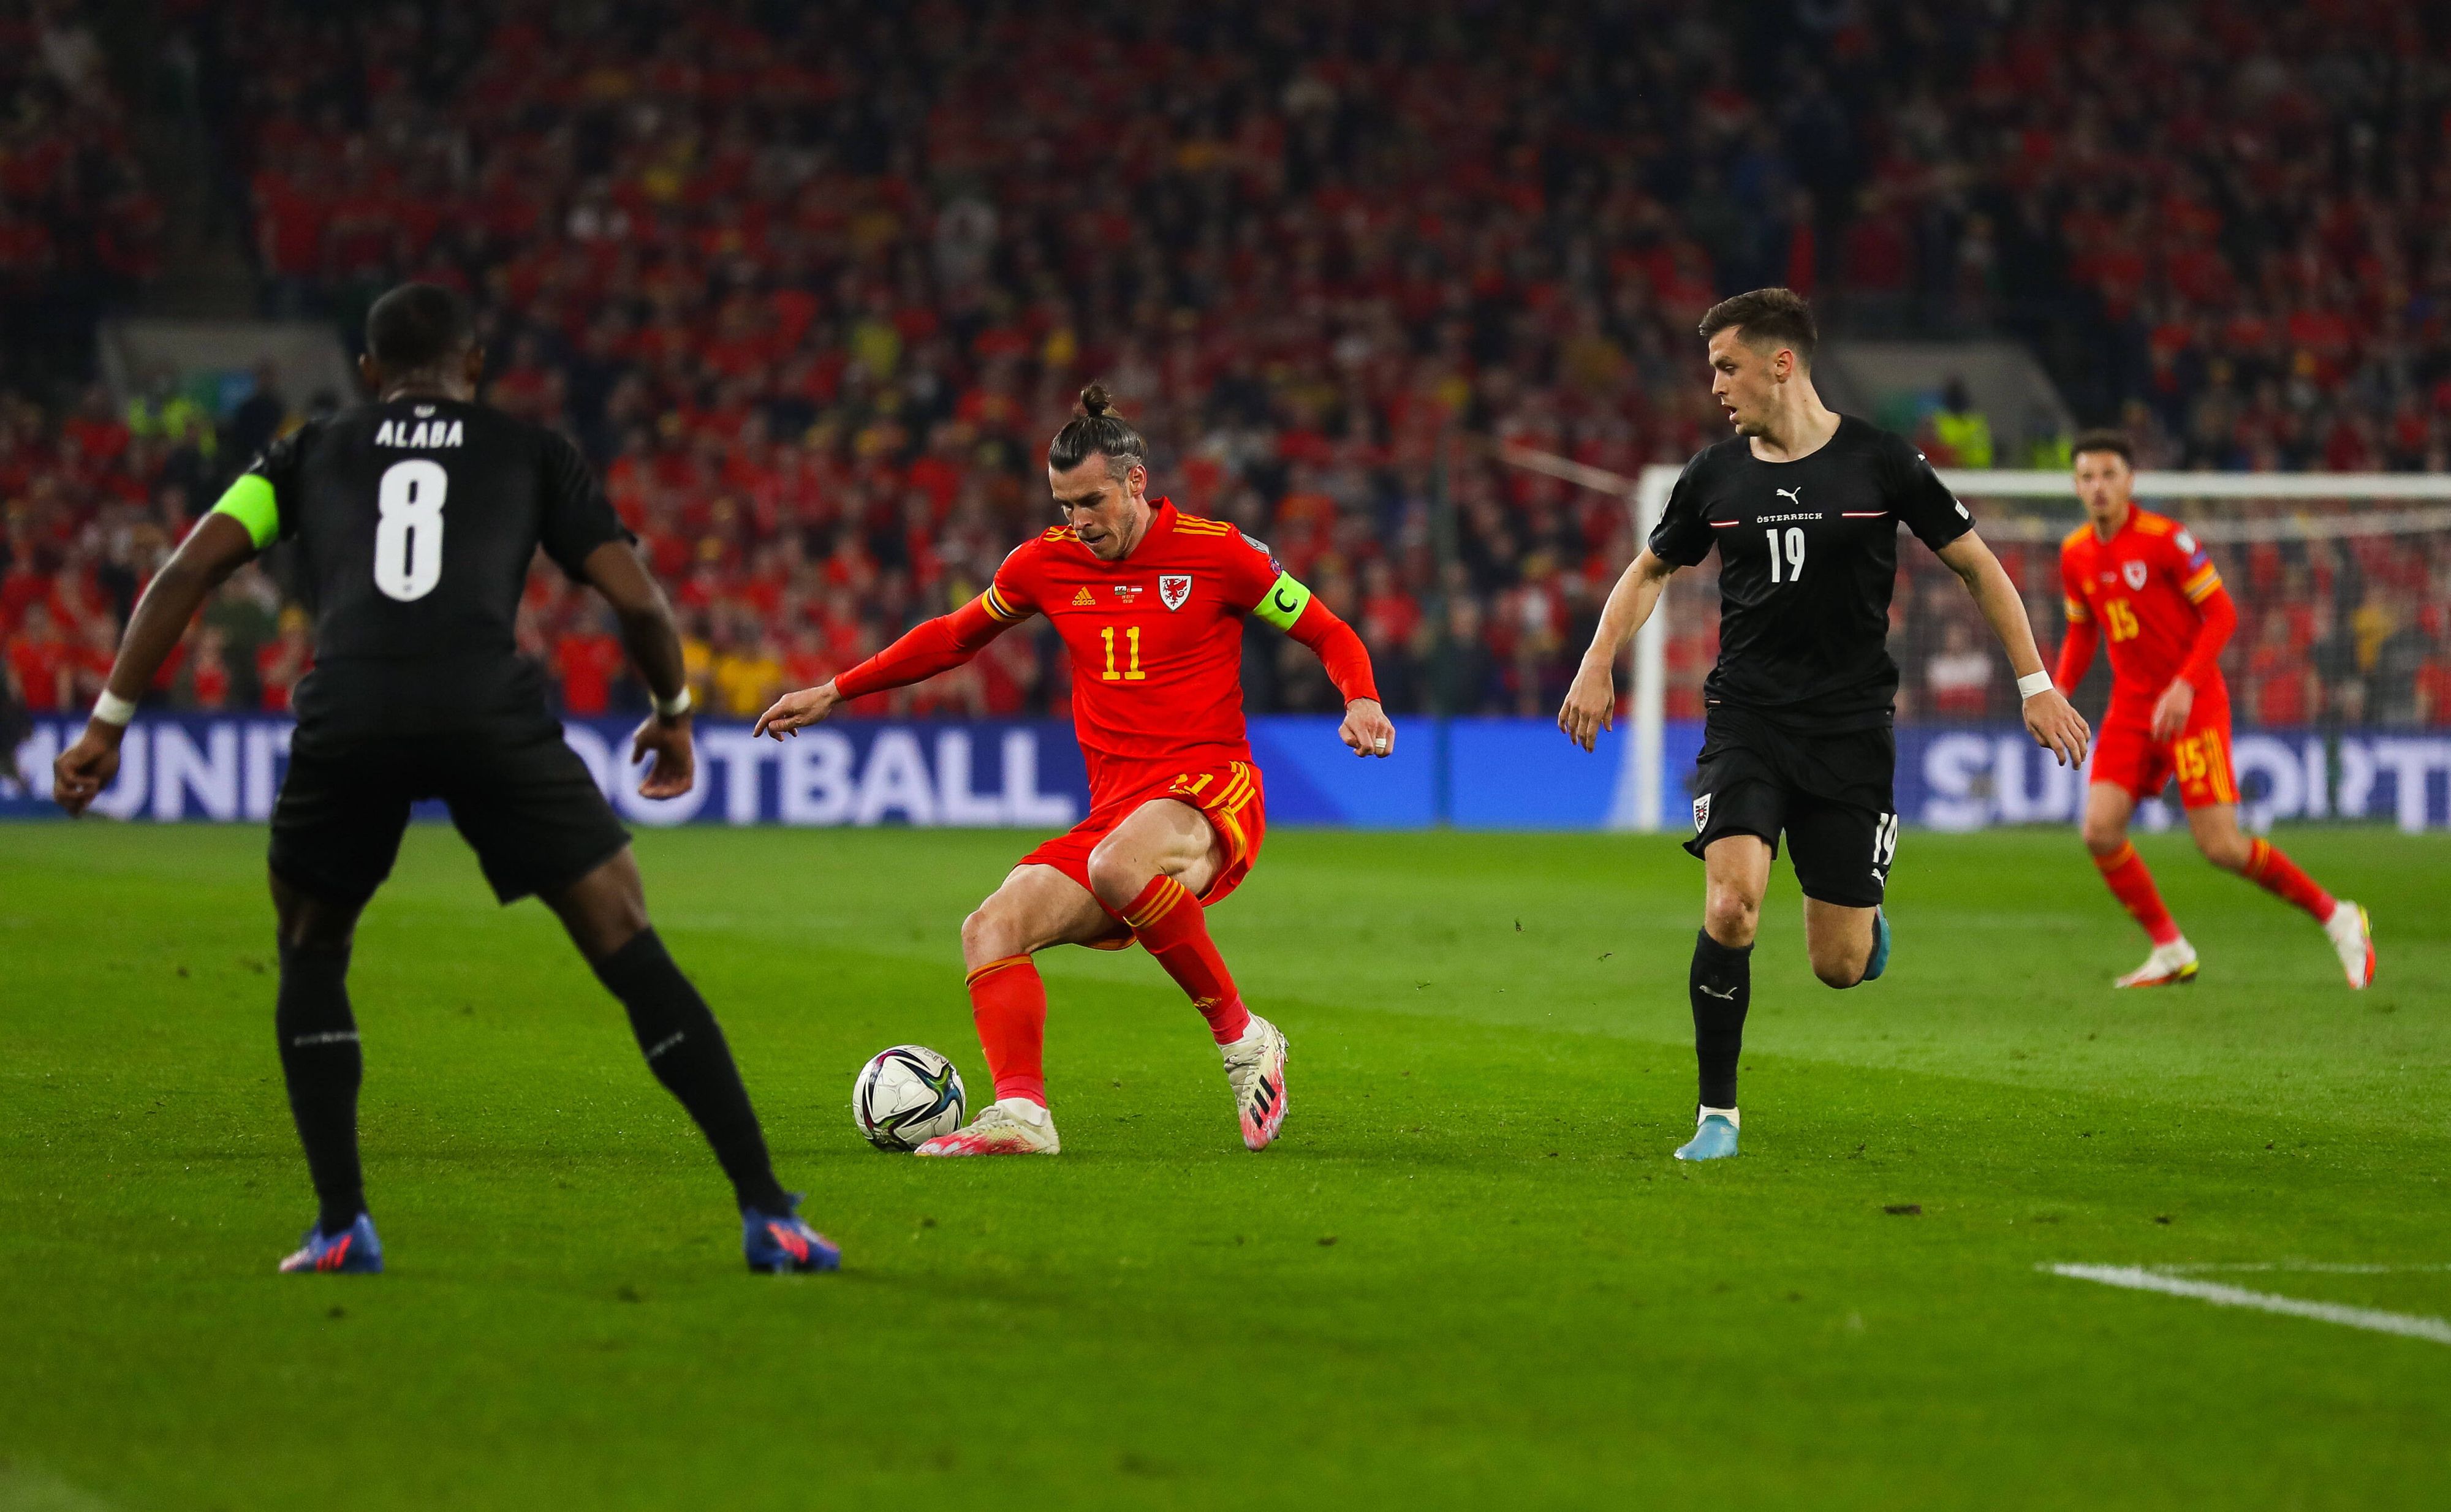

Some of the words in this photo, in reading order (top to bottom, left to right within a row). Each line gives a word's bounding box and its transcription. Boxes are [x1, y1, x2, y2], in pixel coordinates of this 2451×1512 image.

[374, 419, 464, 448] ALABA
[373, 458, 449, 602] 8
[1766, 527, 1806, 583] 19
[1274, 587, 1298, 613] C
[2104, 597, 2140, 643] 15
[1100, 626, 1146, 681] 11
[1923, 731, 2451, 834] SUORT
[2173, 736, 2207, 782] 15
[1872, 812, 1898, 866] 19
